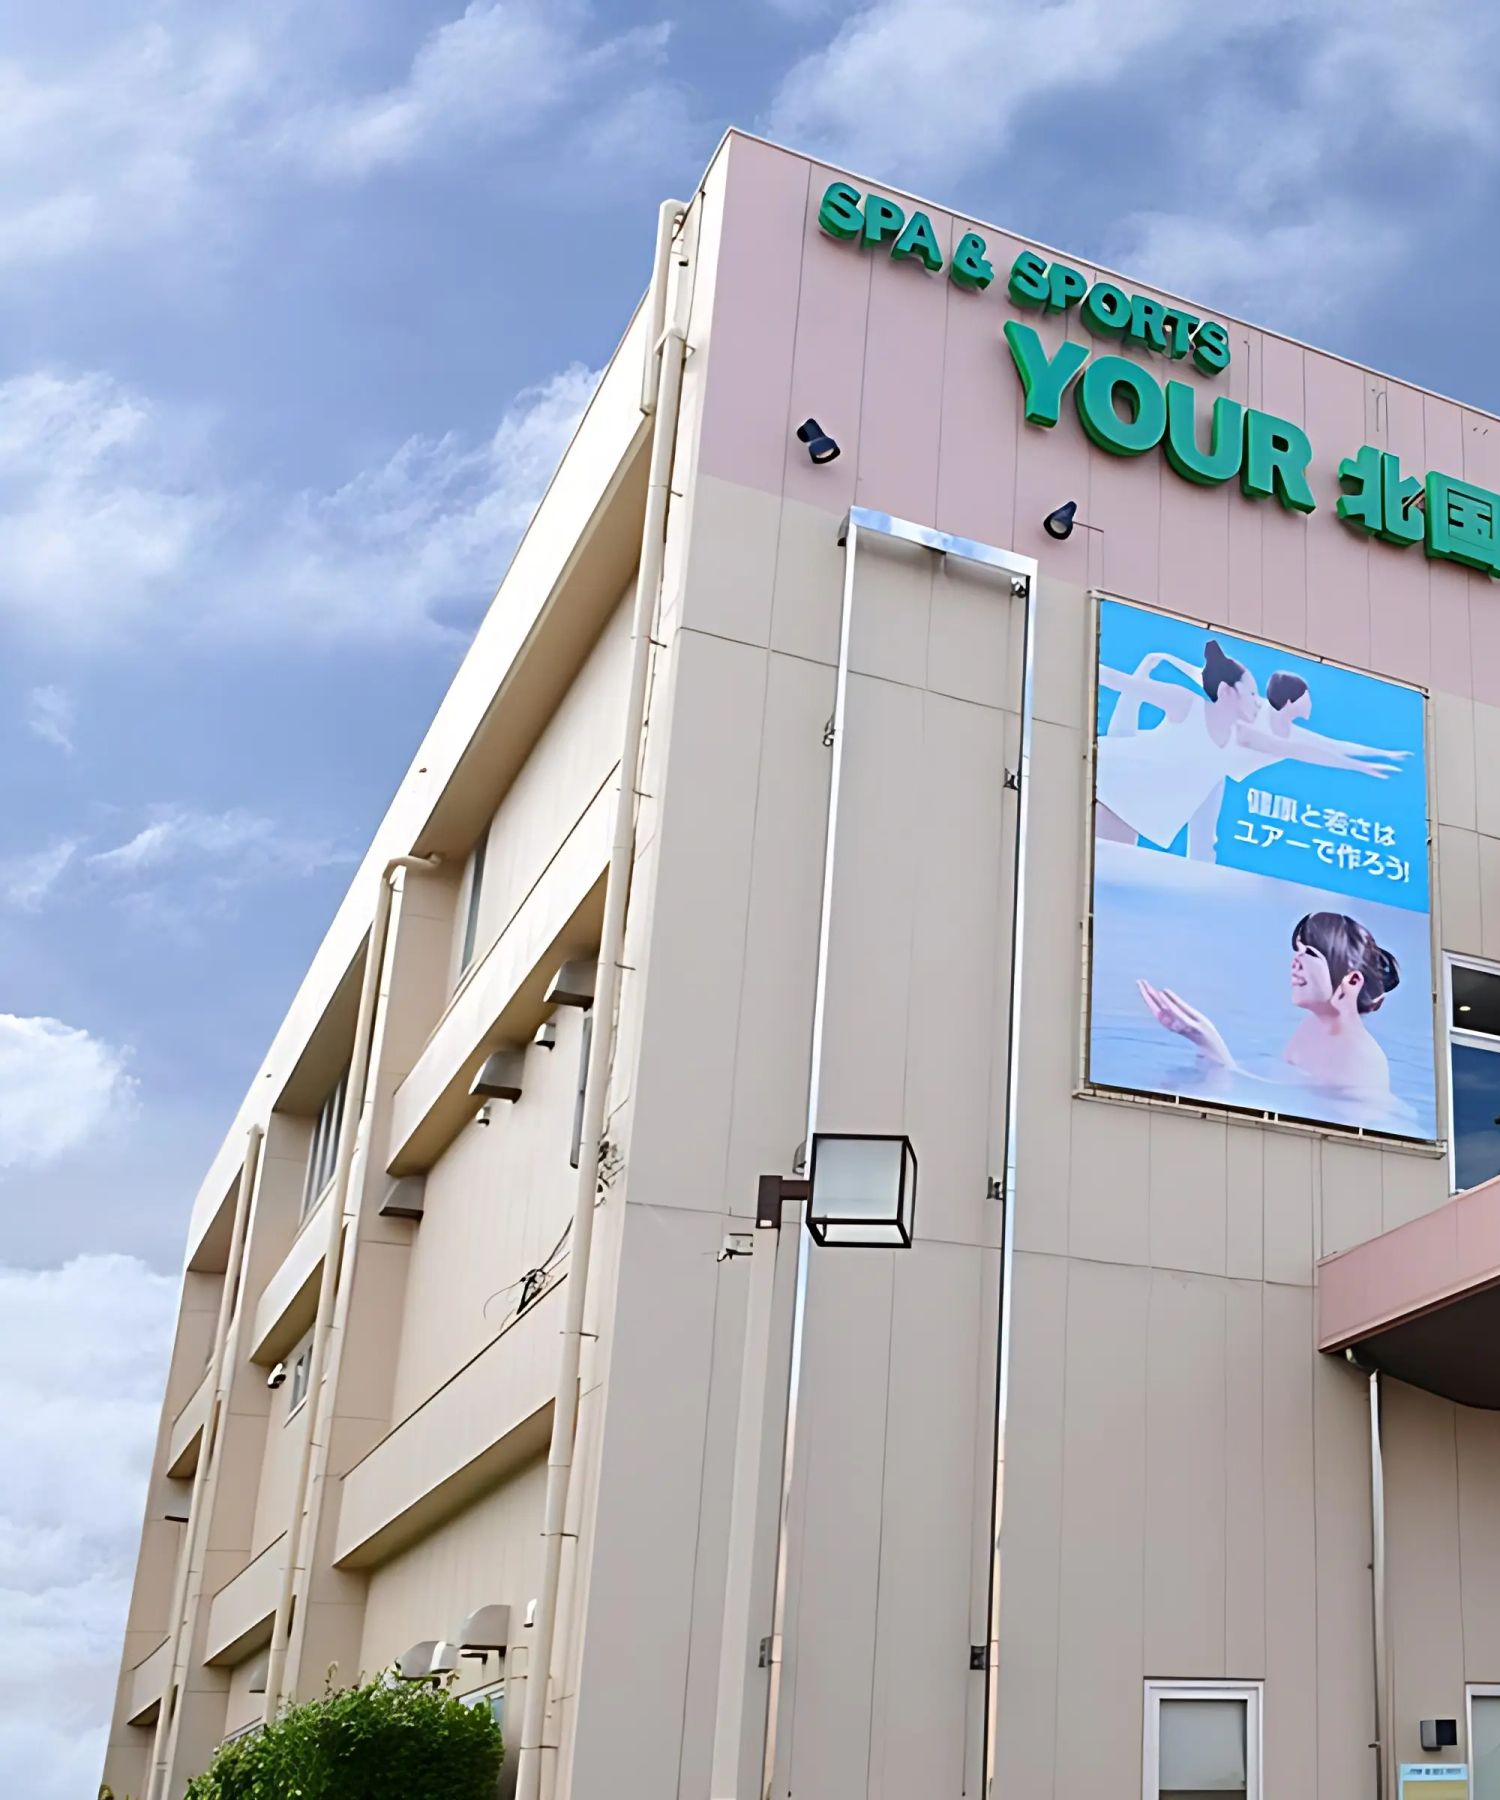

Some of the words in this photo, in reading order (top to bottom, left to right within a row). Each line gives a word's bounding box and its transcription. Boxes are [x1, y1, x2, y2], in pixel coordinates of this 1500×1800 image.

[818, 181, 943, 272] SPA
[949, 230, 994, 290] &
[1007, 250, 1231, 375] SPORTS
[1003, 319, 1316, 513] YOUR
